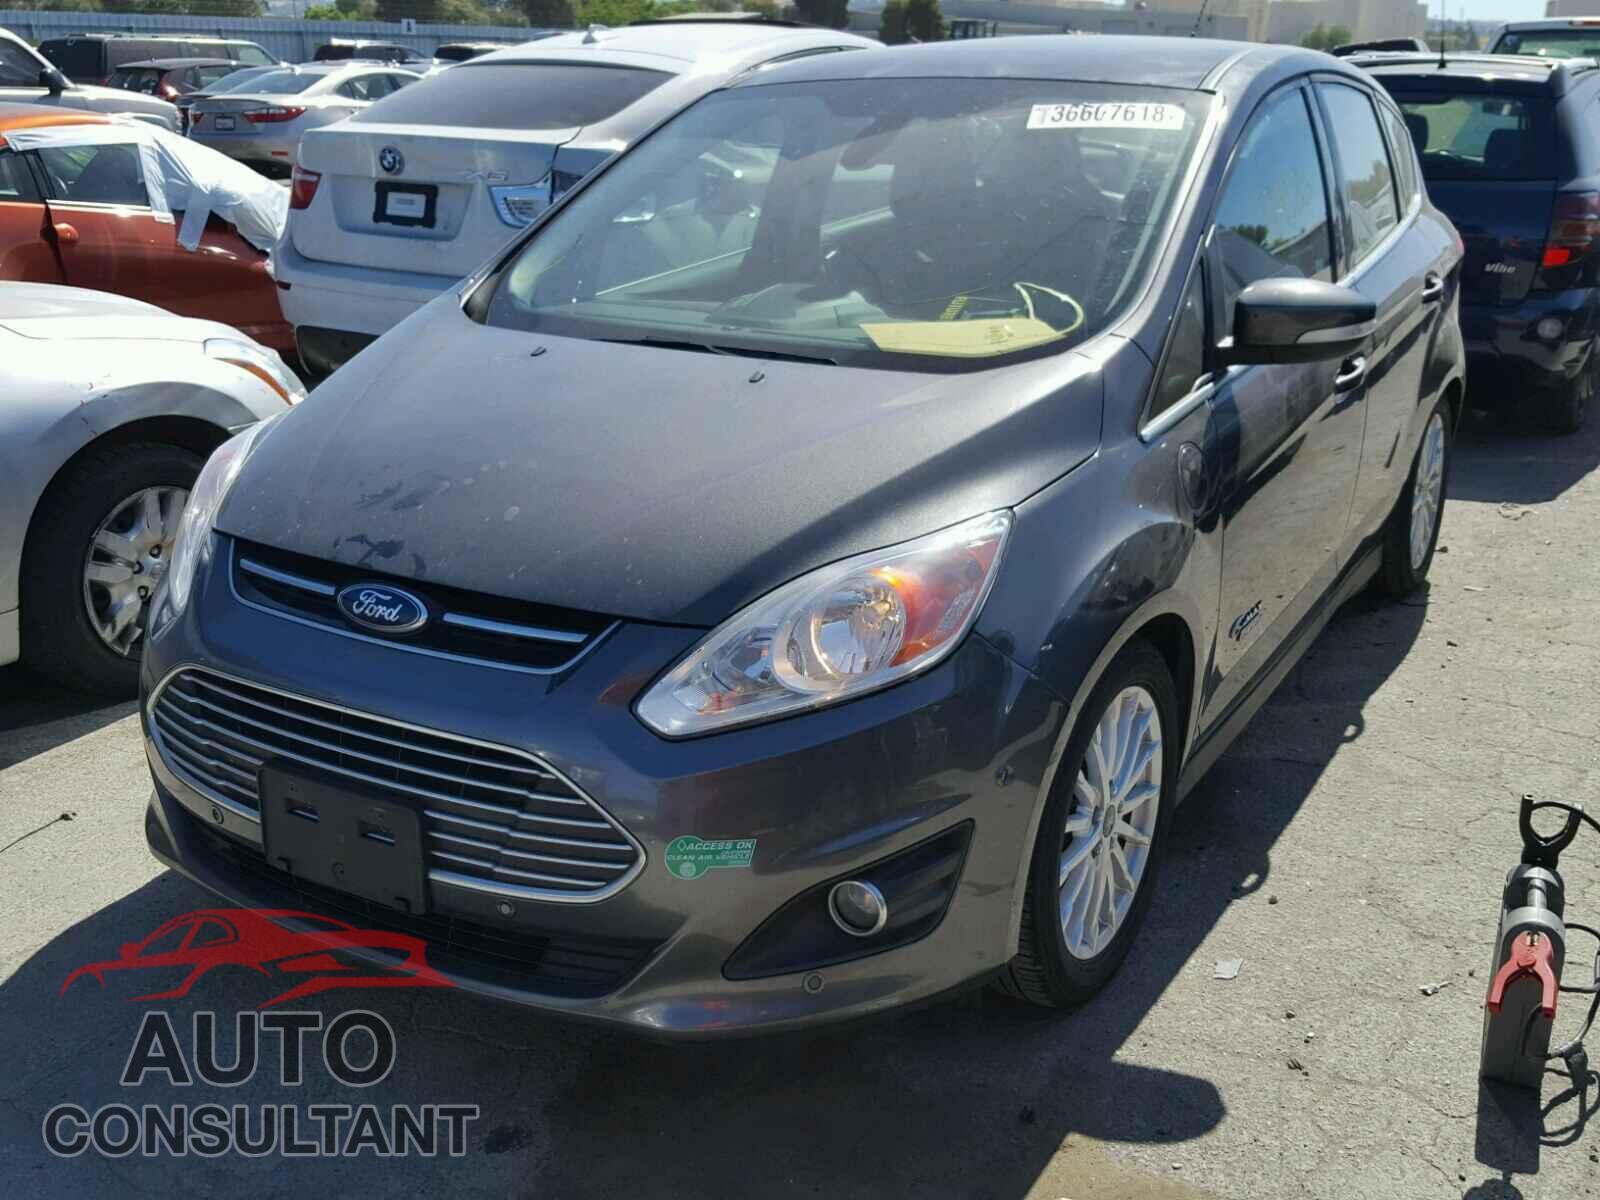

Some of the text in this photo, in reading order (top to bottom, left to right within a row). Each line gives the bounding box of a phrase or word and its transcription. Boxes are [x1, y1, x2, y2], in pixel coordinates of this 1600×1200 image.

[352, 589, 403, 622] Ford
[686, 841, 752, 850] ACCESS OK
